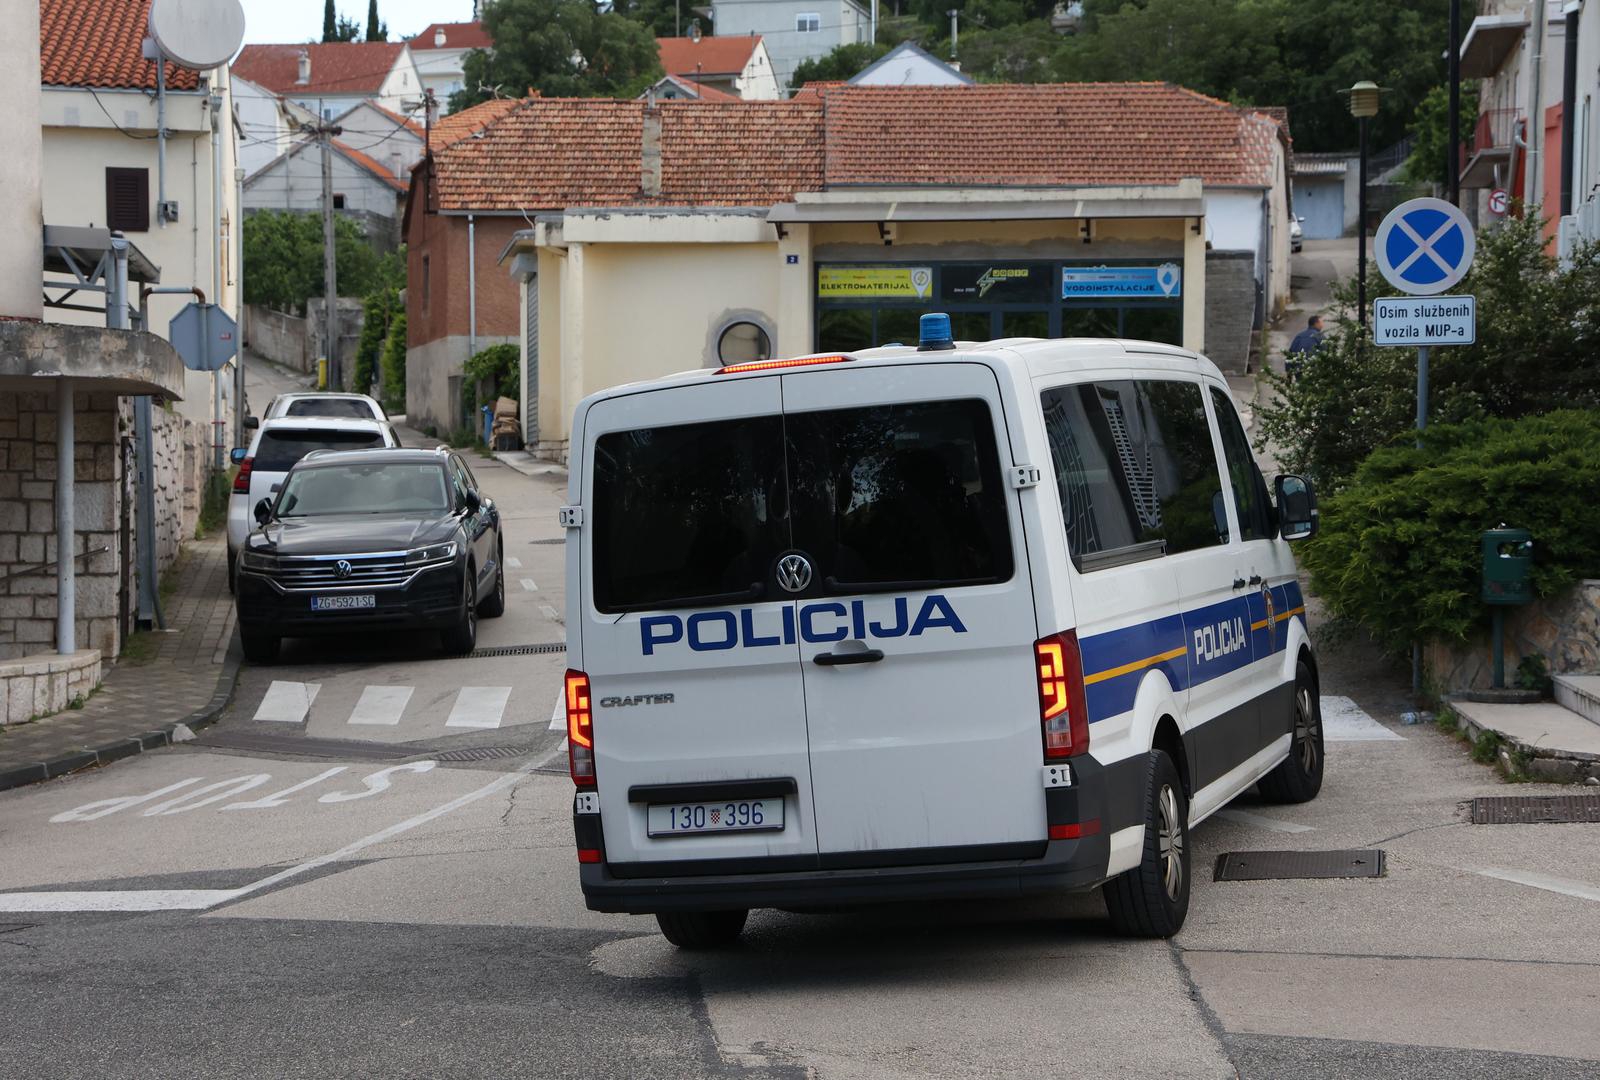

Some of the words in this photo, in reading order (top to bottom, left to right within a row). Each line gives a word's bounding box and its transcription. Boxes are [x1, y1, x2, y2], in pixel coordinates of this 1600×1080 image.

[1065, 284, 1155, 292] VODOINSTALACIJE
[1379, 306, 1408, 319] Osim
[1414, 304, 1470, 318] službenih
[1385, 325, 1419, 338] vozila
[1425, 324, 1465, 337] MUP-a
[318, 597, 331, 609] ZG
[639, 594, 968, 656] POLICIJA
[1193, 616, 1247, 665] POLICIJA
[599, 693, 675, 708] CRAFTER
[670, 805, 706, 830] 130
[724, 802, 764, 826] 396
